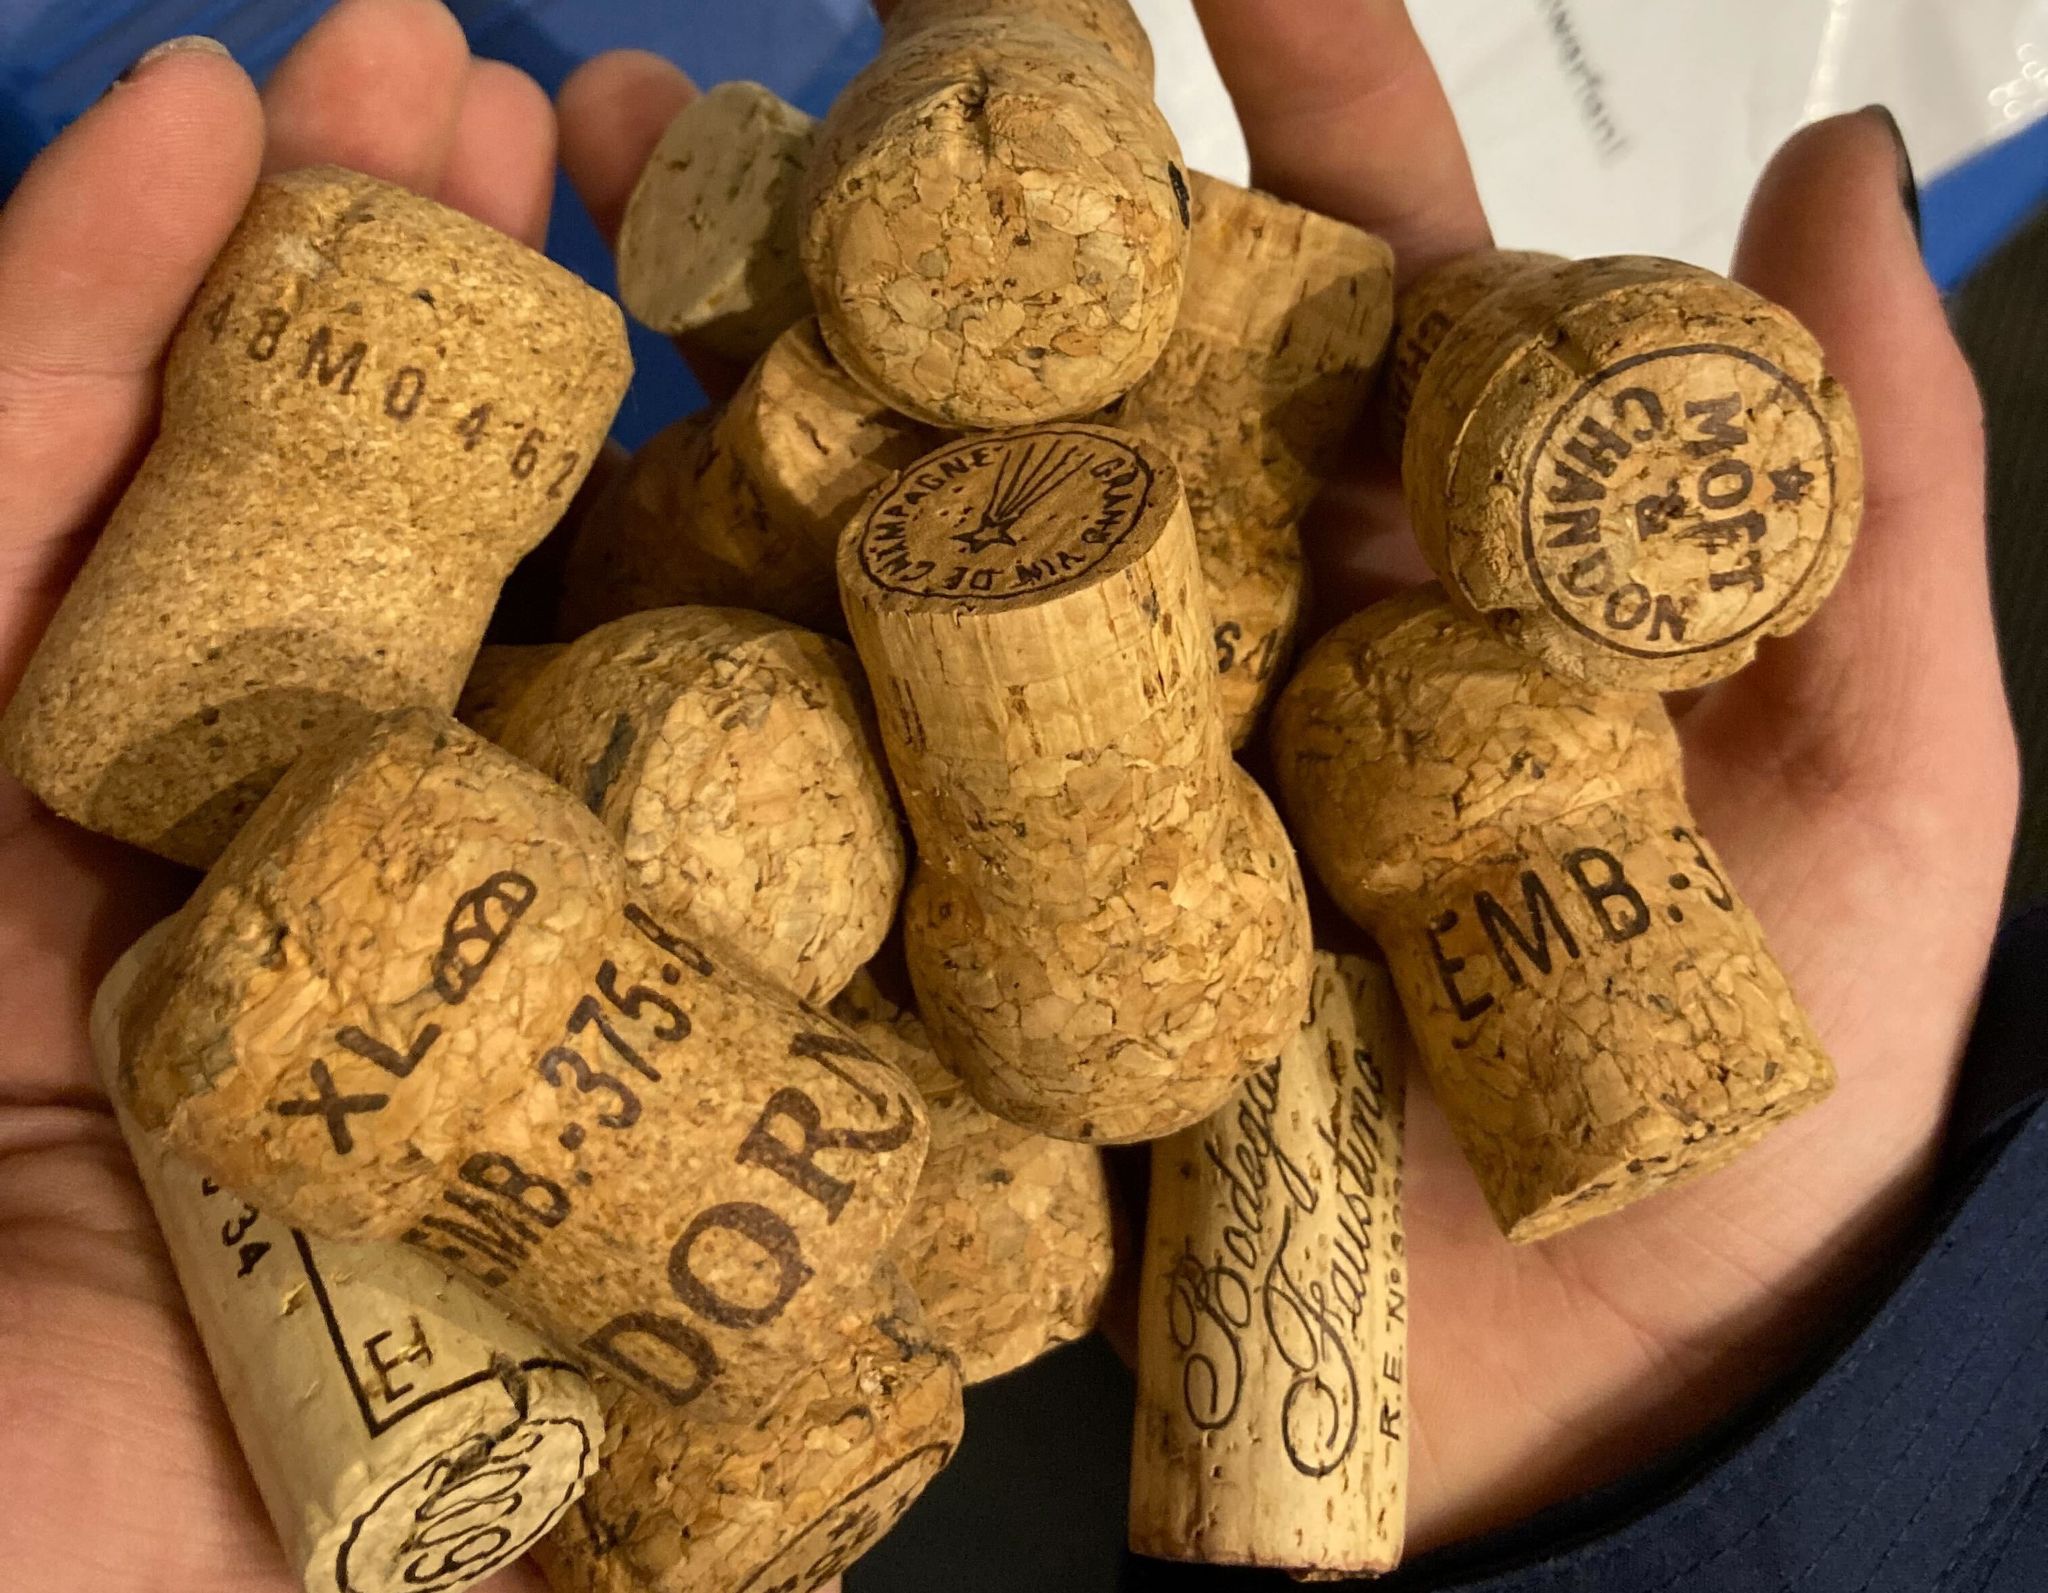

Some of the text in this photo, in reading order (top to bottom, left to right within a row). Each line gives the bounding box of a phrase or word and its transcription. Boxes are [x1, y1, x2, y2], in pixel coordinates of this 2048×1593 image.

[873, 446, 1139, 591] GRAND VIN DE CHAMPAGNE
[1543, 386, 1688, 642] CHANDON
[270, 1022, 442, 1155] XL
[1263, 1049, 1384, 1477] Faustino
